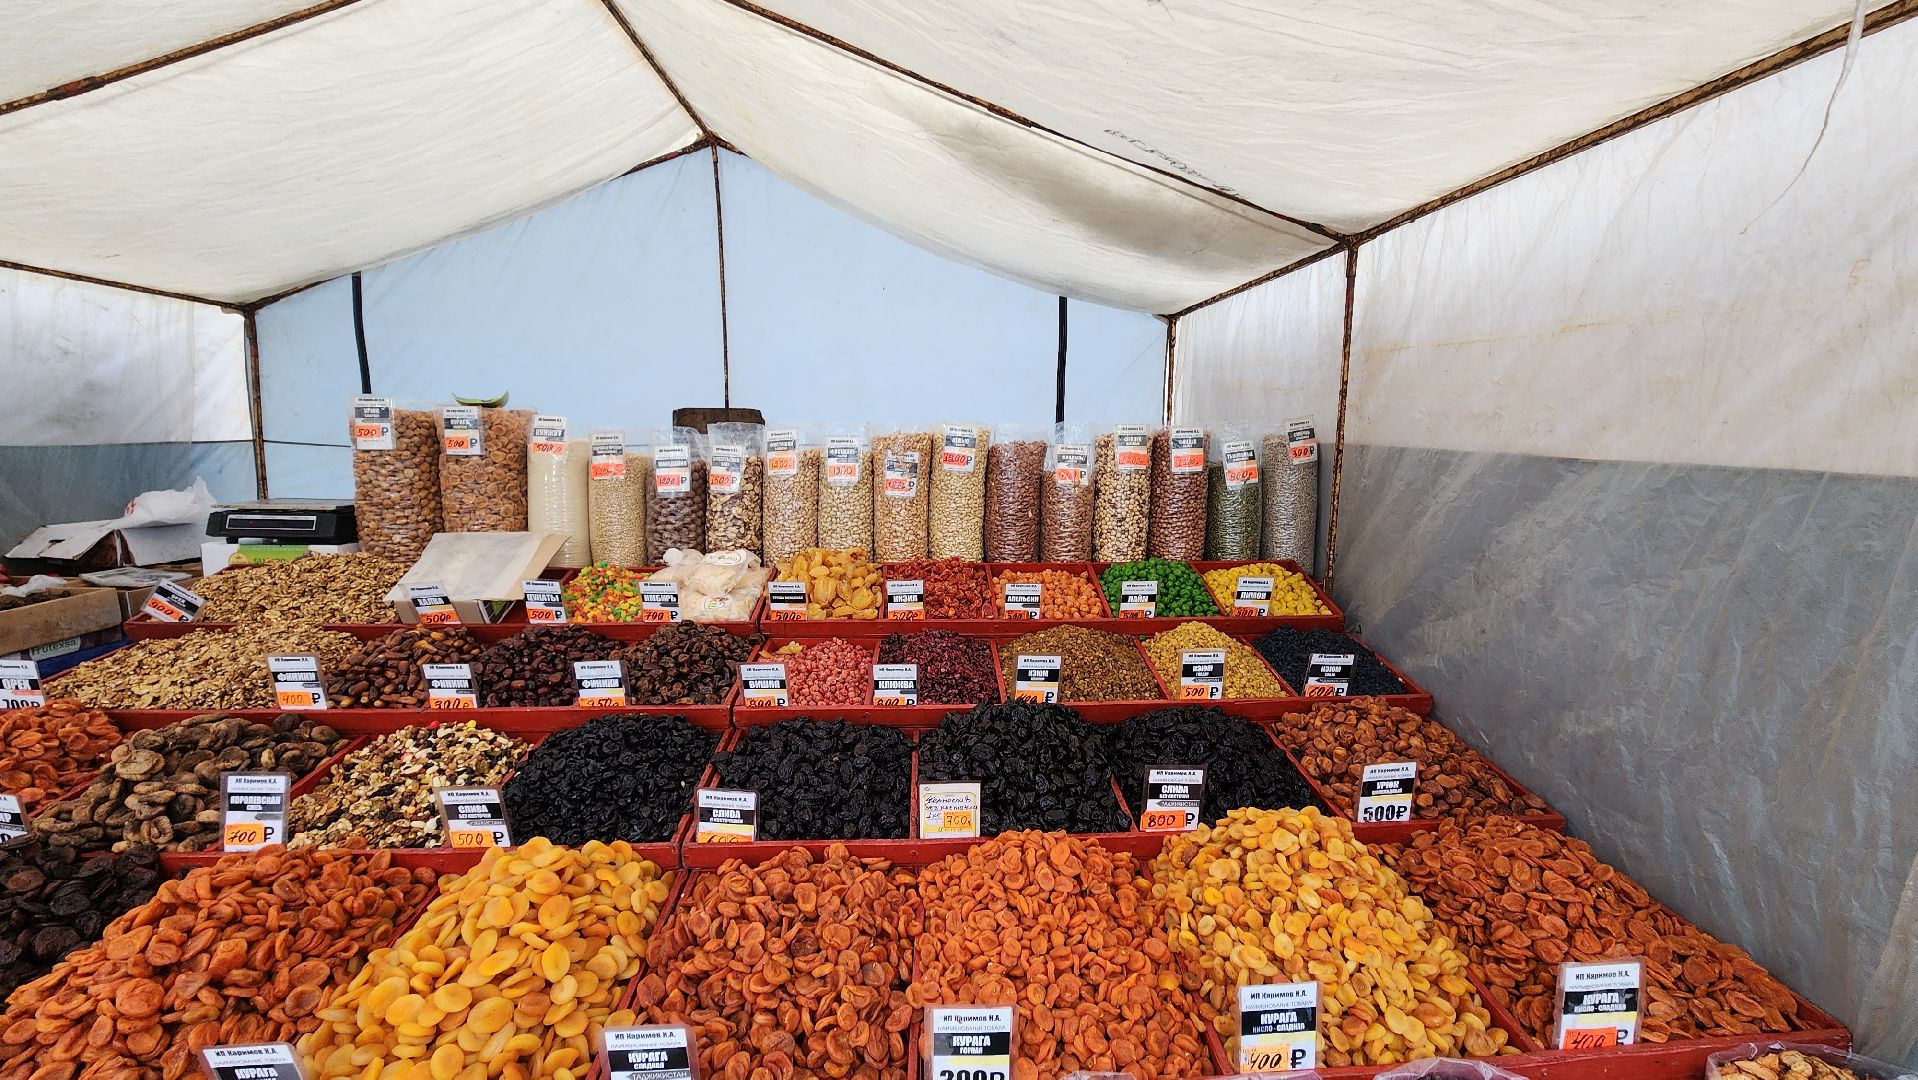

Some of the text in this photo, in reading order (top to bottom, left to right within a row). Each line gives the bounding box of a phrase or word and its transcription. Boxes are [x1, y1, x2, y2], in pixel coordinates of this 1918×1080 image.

[447, 440, 465, 448] 500
[1293, 448, 1309, 457] 300
[418, 597, 445, 606] ХАЛВА
[643, 594, 676, 602] ИМБИРЬ
[530, 610, 551, 619] 500
[645, 611, 664, 620] 700
[1028, 669, 1049, 678] ИЗЮМ
[748, 680, 781, 689] ВИШНЯ
[878, 679, 915, 689] КЛЮКВА
[1184, 687, 1206, 697] 500
[282, 696, 304, 704] 400
[1161, 785, 1189, 794] СЛИВА
[458, 804, 488, 813] СЛИВА
[712, 809, 741, 818] СЛИВА
[1147, 814, 1176, 828] 800
[228, 831, 257, 843] 700
[459, 832, 484, 846] 500
[1575, 973, 1585, 981] ИП
[1262, 991, 1294, 999] Каримов
[1582, 992, 1620, 1006] КУРАГА
[1260, 1012, 1298, 1025] КУРАГА
[953, 1035, 991, 1046] КУРАГА
[1571, 1032, 1606, 1050] 400
[628, 1051, 668, 1063] КУРАГА
[1250, 1053, 1283, 1070] 400
[235, 1067, 279, 1079] КУРАГА
